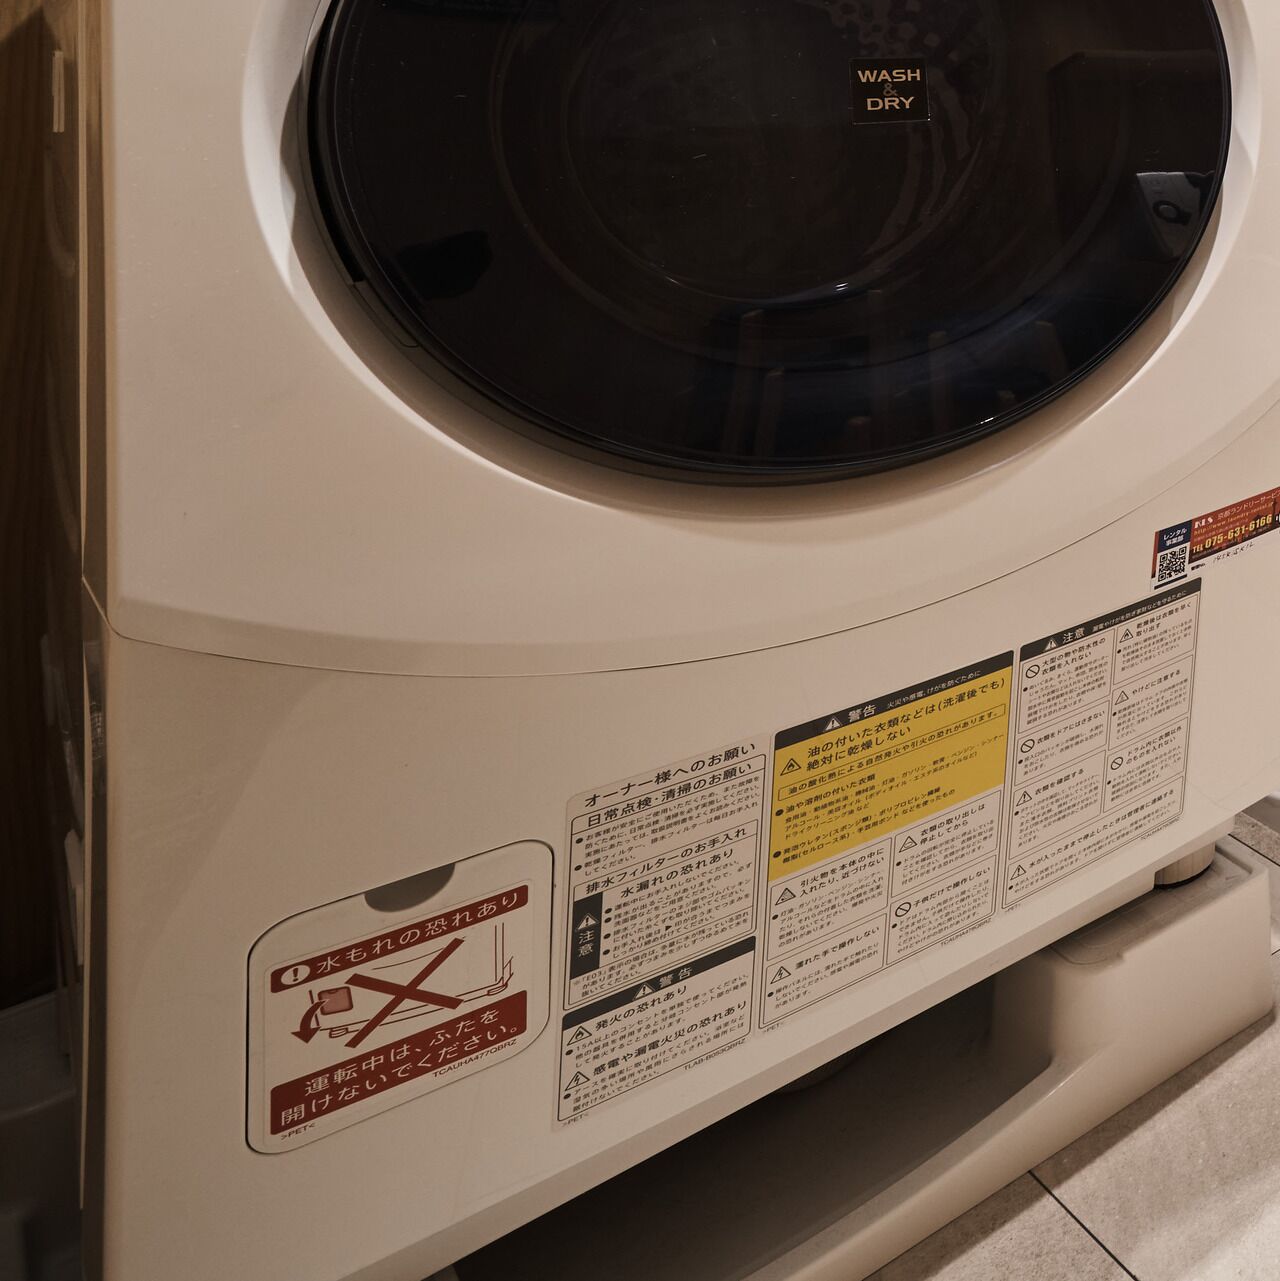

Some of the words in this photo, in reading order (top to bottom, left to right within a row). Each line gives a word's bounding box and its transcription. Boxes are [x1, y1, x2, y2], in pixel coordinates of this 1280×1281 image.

[858, 69, 920, 82] WASH
[883, 83, 898, 96] &
[867, 97, 914, 110] DRY
[1163, 528, 1187, 540] レンタル
[1192, 545, 1204, 554] TEL
[1205, 514, 1272, 549] 075-631-6166
[1062, 625, 1085, 644] 注意
[847, 702, 876, 724] 警告
[788, 708, 999, 796] 油の酸化熱による自然発火や引火の恐れがあります。
[806, 724, 911, 772] 絶対に乾燥しない
[584, 741, 756, 809] オーナー様へのお願い
[587, 761, 752, 828] 日常点検・清掃のお願い
[586, 826, 746, 895] 排水フィルターのお手入れ
[620, 847, 734, 899] 水漏れの恐れあり
[316, 891, 518, 973] 水もれの恐れあり
[659, 964, 692, 989] 警告
[595, 982, 687, 1032] 発火の恐れあり
[304, 1008, 499, 1097] 運転中は、ふたを
[592, 998, 746, 1078] 感電や漏電火災の恐れあり
[281, 1025, 518, 1127] 開けないでください。
[280, 1122, 316, 1140] >PET<
